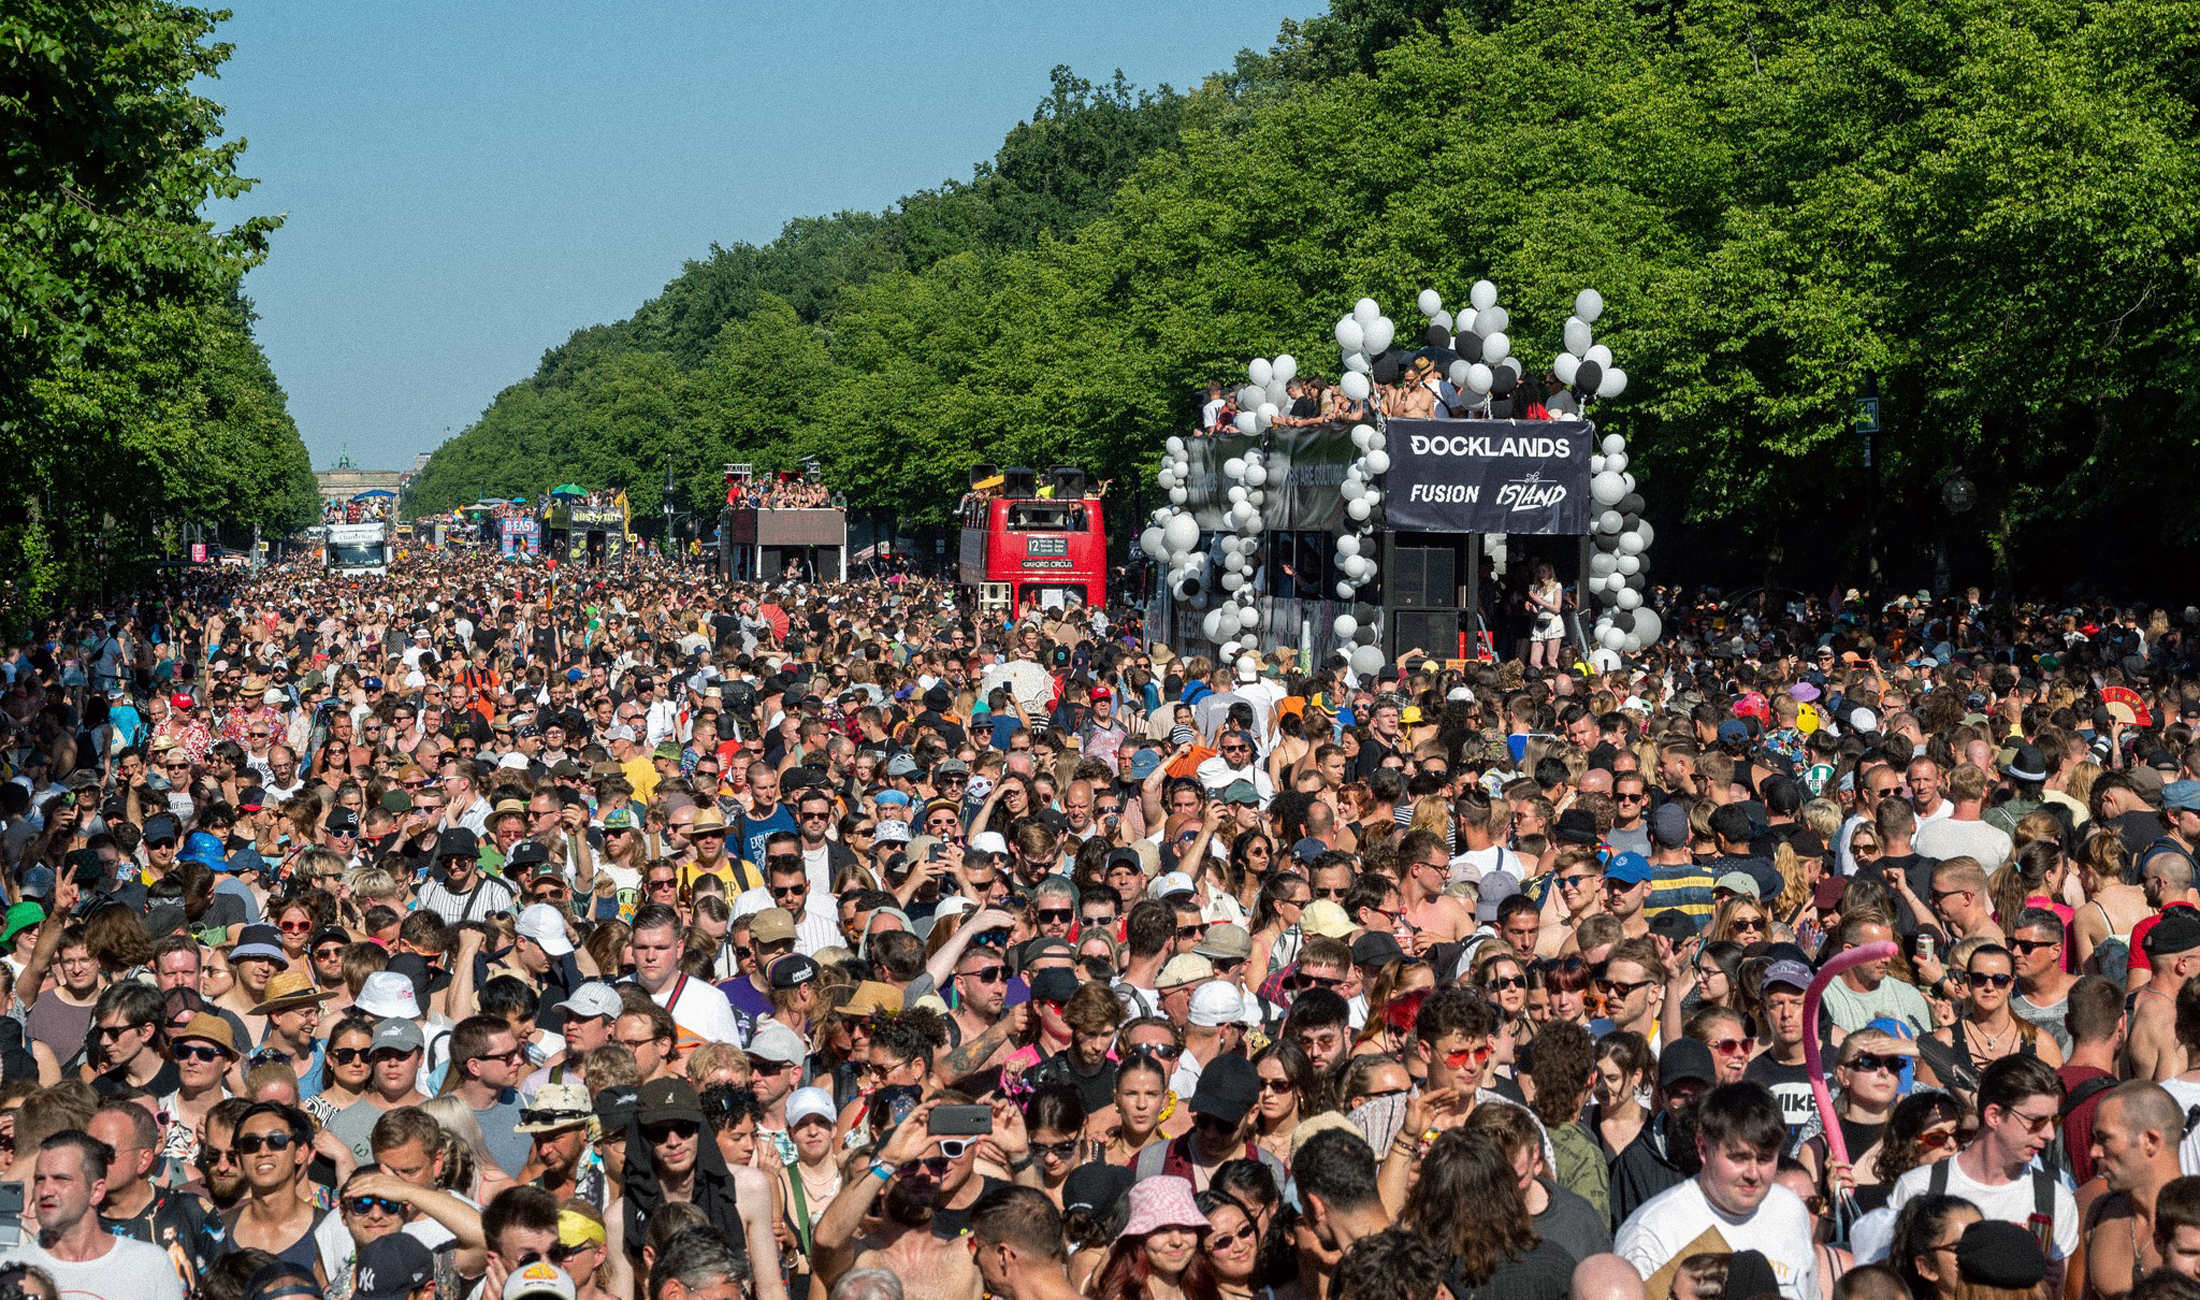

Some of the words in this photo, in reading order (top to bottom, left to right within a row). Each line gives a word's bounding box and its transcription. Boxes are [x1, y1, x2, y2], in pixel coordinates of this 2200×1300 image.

[1410, 435, 1571, 459] DOCKLANDS
[1410, 484, 1480, 503] FUSION
[1496, 483, 1567, 512] ISLAND
[1028, 539, 1039, 551] 12
[257, 761, 274, 780] YORK
[358, 1266, 376, 1292] NY
